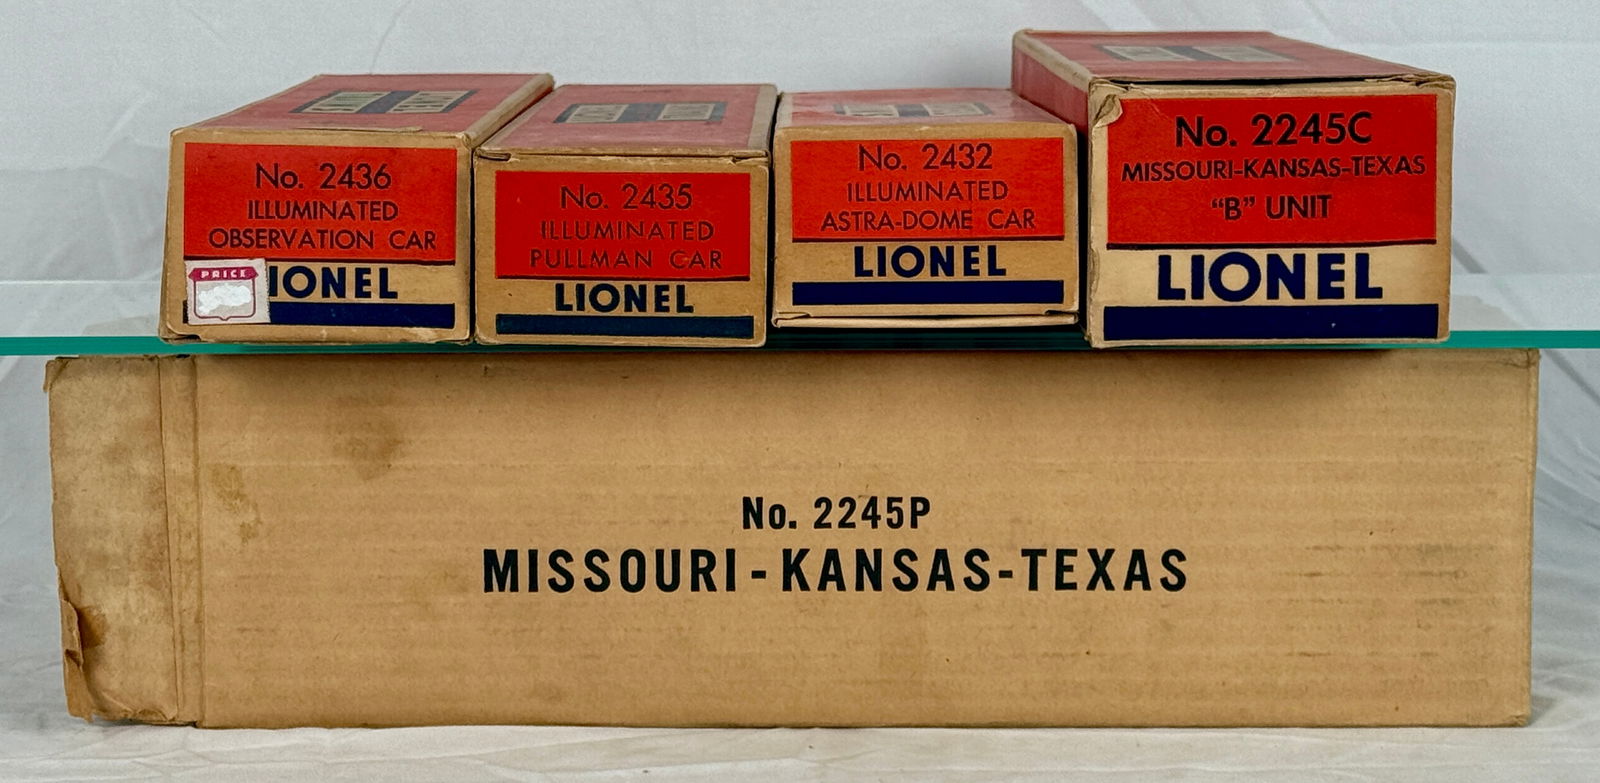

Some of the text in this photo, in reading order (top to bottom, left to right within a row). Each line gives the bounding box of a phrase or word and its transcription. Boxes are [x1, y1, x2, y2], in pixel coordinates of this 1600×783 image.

[1175, 111, 1373, 148] No. 2245C
[858, 142, 993, 171] No. 2432
[1121, 155, 1426, 182] MISSOURI-KANSAS-TEXAS
[255, 162, 392, 190] No. 2436
[560, 183, 693, 210] No. 2435
[847, 180, 1009, 202] ILLUMINATED
[247, 200, 399, 222] ILLUMINATED
[820, 208, 1035, 232] ASTRA-DOME CAR
[1265, 194, 1333, 220] UNIT
[208, 227, 437, 250] OBSERVATION CAR
[540, 220, 715, 241] ILLUMINATED
[530, 249, 723, 269] PULLMAN CAR
[854, 245, 1007, 278] LIONEL
[201, 269, 246, 279] PRICE
[269, 266, 399, 299] IONEL
[1157, 251, 1384, 302] LIONEL
[555, 283, 694, 313] LIONEL
[741, 496, 932, 530] No. 2245P
